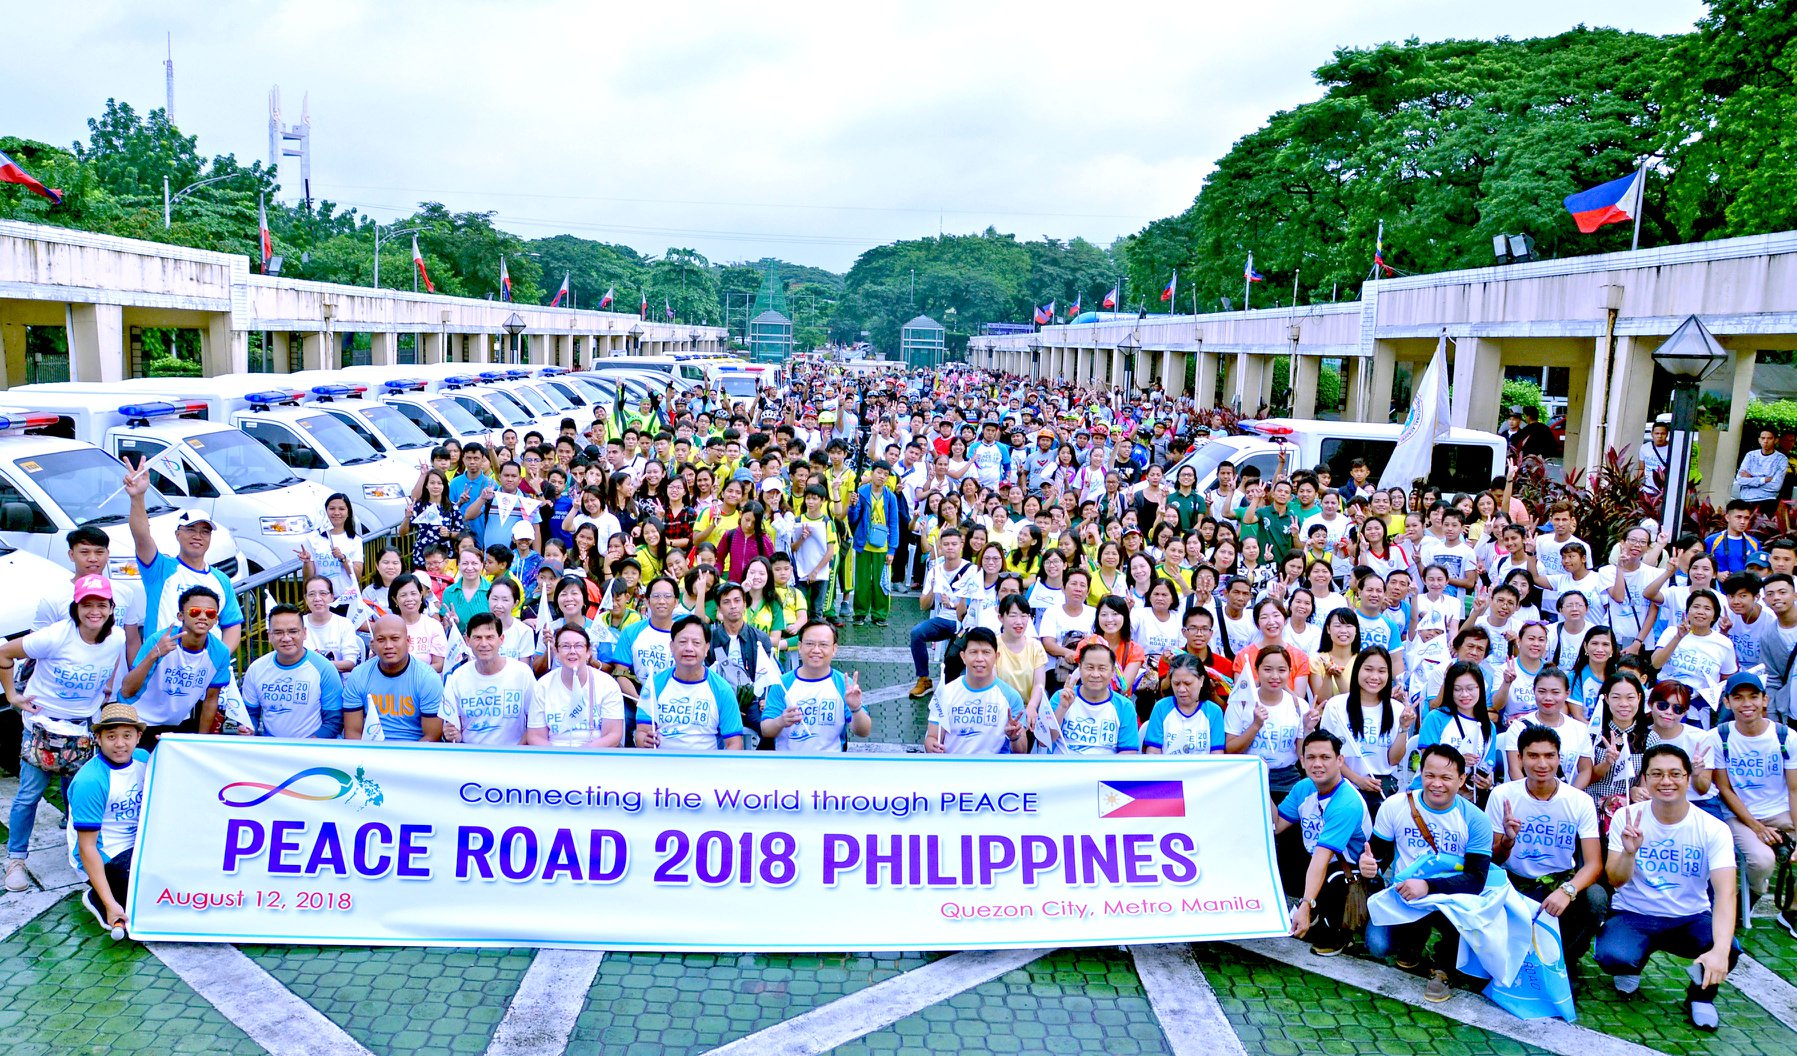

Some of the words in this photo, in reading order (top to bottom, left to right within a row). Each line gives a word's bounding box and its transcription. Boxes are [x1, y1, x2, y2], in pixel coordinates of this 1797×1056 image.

[416, 636, 428, 644] 20
[1360, 632, 1387, 644] EACE
[54, 666, 98, 682] PEACE
[164, 667, 195, 681] PEACE
[55, 678, 95, 691] ROAD
[164, 677, 192, 688] ROAD
[261, 683, 294, 693] PEACE
[296, 682, 308, 692] 20
[264, 692, 292, 702] ROAD
[295, 692, 307, 701] 18
[1514, 687, 1535, 695] PEAC
[461, 695, 502, 708] PEACE
[505, 691, 521, 703] 20
[465, 706, 502, 718] ROAD
[505, 704, 519, 715] 18
[657, 703, 692, 715] PEACE
[695, 700, 709, 711] 20
[797, 706, 818, 716] ACE
[821, 700, 835, 711] 20
[951, 706, 984, 715] PEACE
[986, 704, 998, 714] 20
[657, 713, 692, 725] ROAD
[694, 711, 707, 722] 18
[820, 712, 834, 722] 18
[953, 715, 983, 724] ROAD
[986, 713, 997, 723] 18
[1063, 717, 1098, 735] PEACE
[1102, 720, 1116, 732] 20
[1062, 729, 1097, 744] ROAD
[1101, 731, 1115, 743] 18
[1198, 732, 1208, 741] 20
[1255, 730, 1279, 741] ACE
[1282, 727, 1296, 738] 20
[1281, 739, 1294, 749] 18
[1729, 767, 1764, 778] ROAD
[458, 781, 642, 812] Connecting
[653, 787, 702, 809] the
[714, 789, 800, 810] World
[811, 790, 929, 817] through
[940, 792, 1038, 813] PEACE
[1301, 817, 1324, 832] EAC
[1519, 822, 1555, 837] EACE
[1559, 822, 1576, 834] 20
[1444, 831, 1458, 843] 20
[1557, 834, 1573, 846] 18
[222, 818, 433, 877] PEACE
[455, 825, 628, 881] ROAD
[653, 829, 797, 885] 2018
[822, 832, 1198, 886] PHILIPPINES
[1443, 842, 1458, 852] 18
[1638, 846, 1679, 861] EACE
[1685, 849, 1701, 861] 20
[1683, 861, 1700, 874] 18
[156, 887, 244, 909] August
[255, 890, 287, 911] 12,
[295, 891, 353, 910] 2018
[941, 901, 1034, 919] Quezon
[1043, 899, 1095, 920] City,
[1104, 898, 1173, 916] Metro
[1181, 896, 1262, 913] Manila
